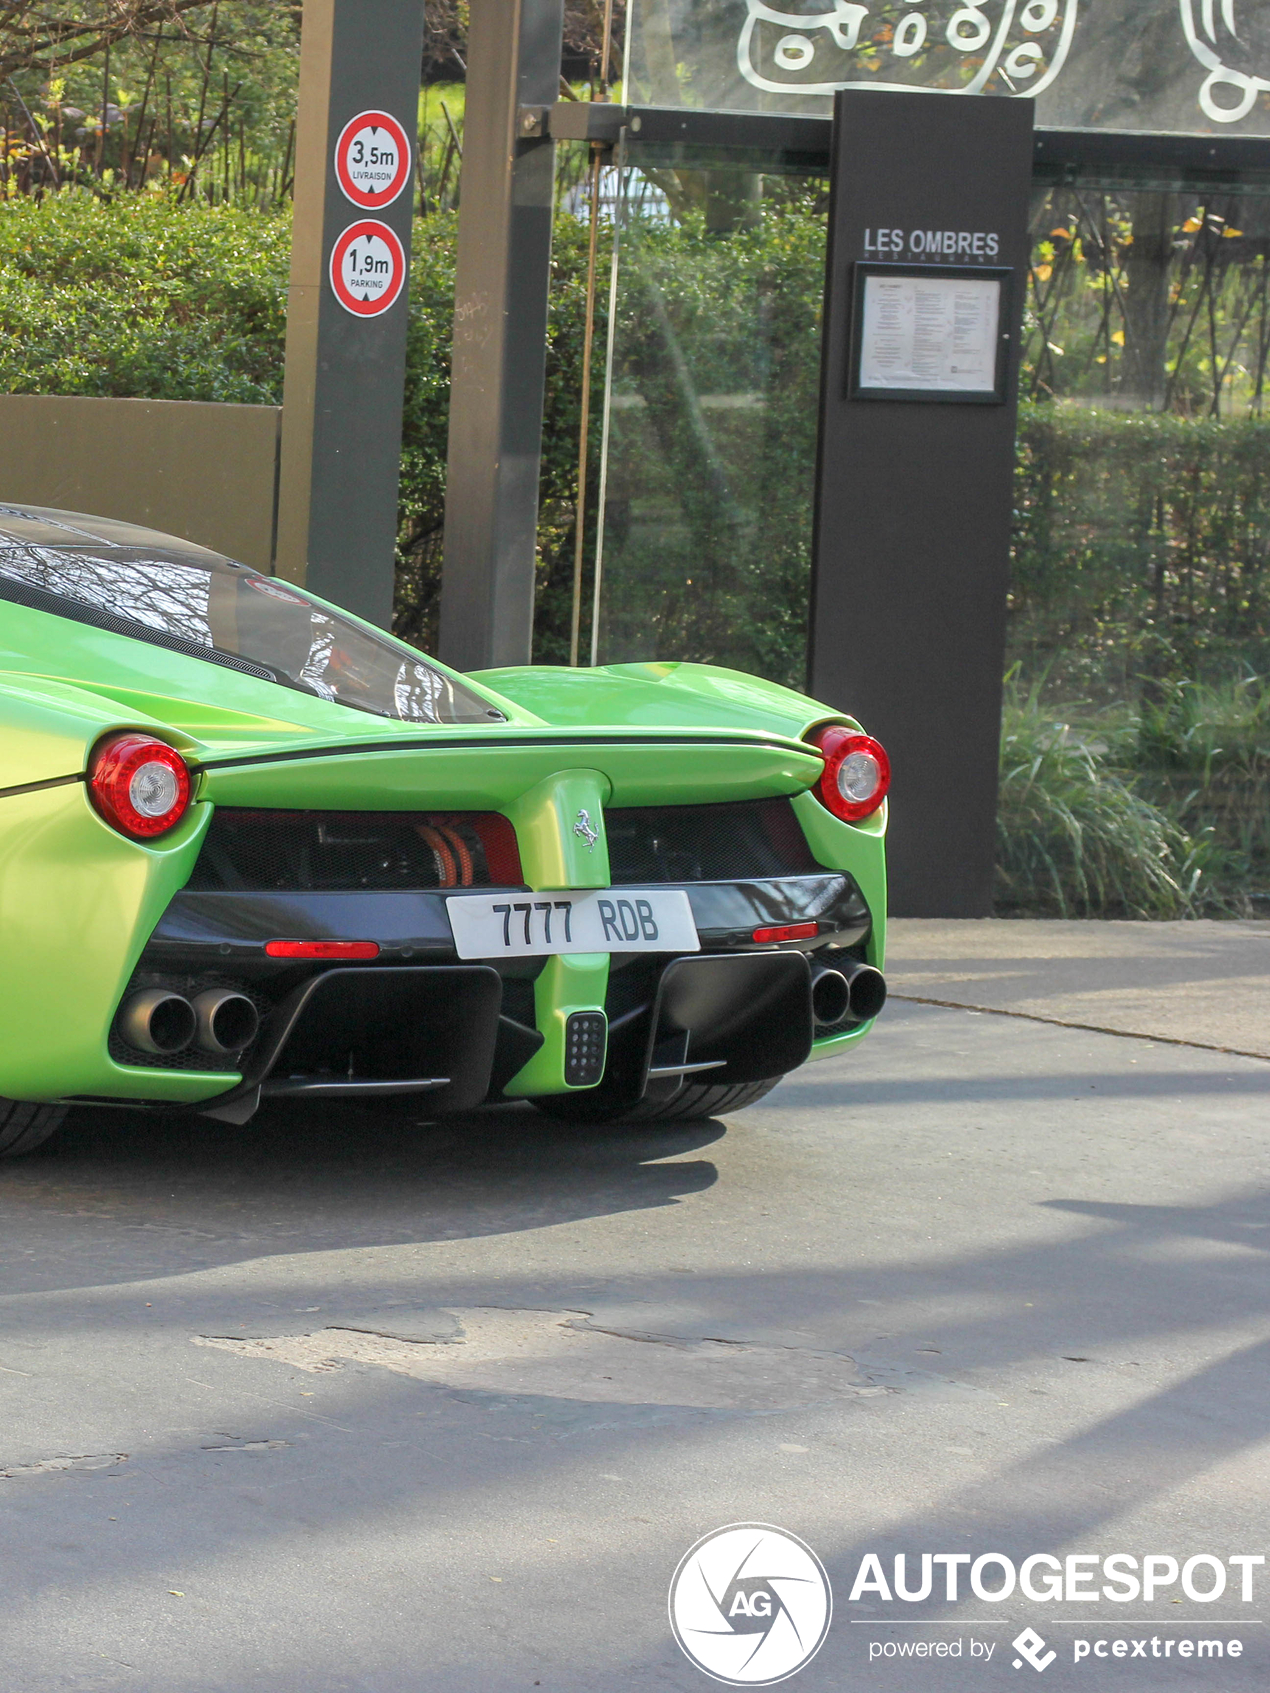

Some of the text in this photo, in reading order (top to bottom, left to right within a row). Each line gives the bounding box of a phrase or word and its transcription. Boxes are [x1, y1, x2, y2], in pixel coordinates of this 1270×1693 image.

[352, 171, 392, 181] LIVRAISON
[863, 228, 1000, 255] LES OMBRES
[350, 279, 383, 289] PARKING
[492, 899, 659, 947] 7777 RDB
